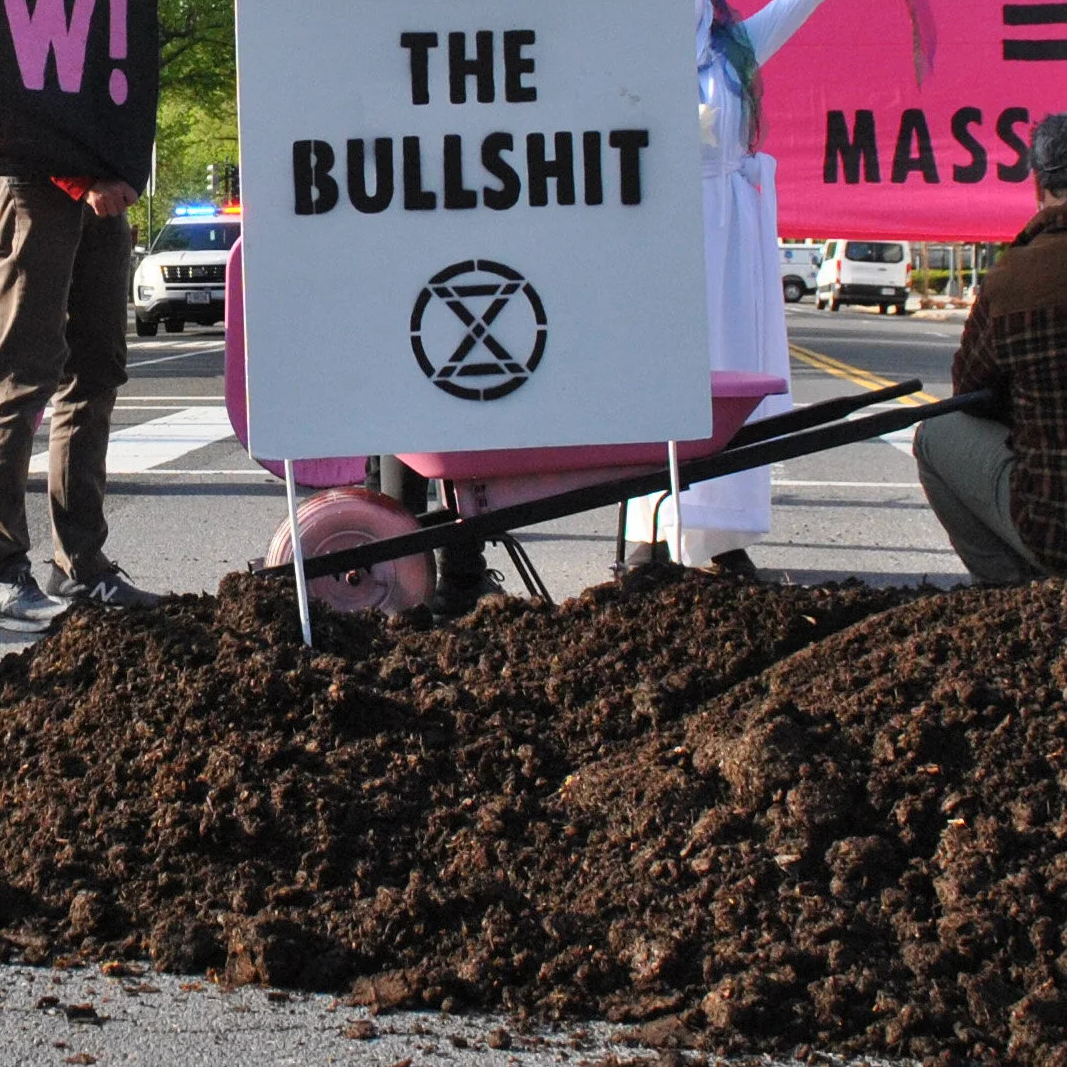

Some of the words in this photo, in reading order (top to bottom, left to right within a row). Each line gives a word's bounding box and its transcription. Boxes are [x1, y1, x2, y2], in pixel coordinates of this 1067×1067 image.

[400, 30, 537, 105] THE
[293, 129, 649, 215] BULLSHIT
[823, 106, 1033, 184] MASS
